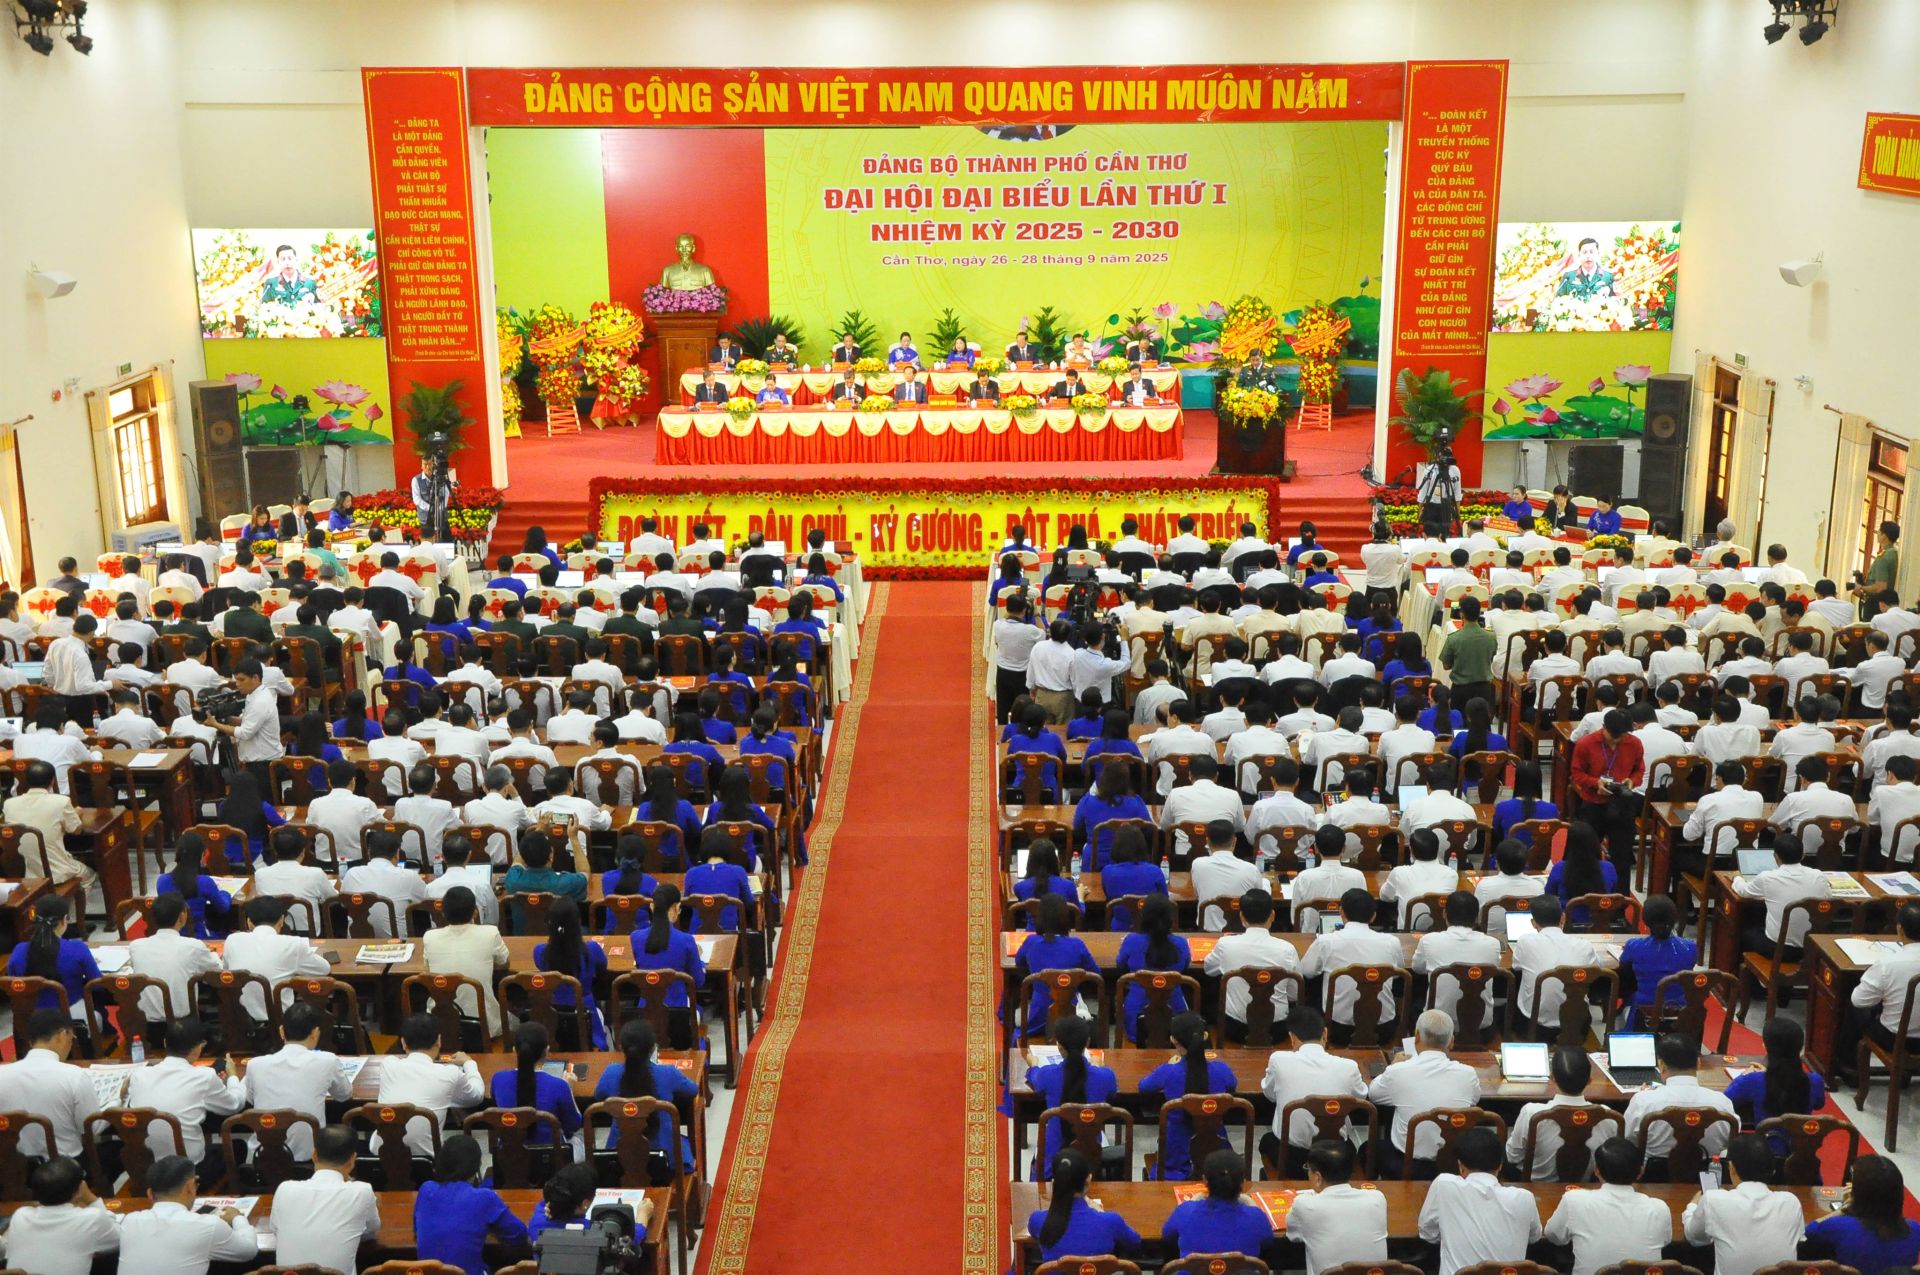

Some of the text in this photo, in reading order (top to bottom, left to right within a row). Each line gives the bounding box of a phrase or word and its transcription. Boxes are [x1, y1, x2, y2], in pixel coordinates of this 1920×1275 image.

[524, 71, 1348, 118] ĐẢNG CỘNG SẢN VIỆT NAM QUANG VINH MUÔN NĂM
[864, 150, 1188, 176] ĐẢNG BỘ THÀNH PHỐ CẦN THƠ
[824, 178, 1227, 213] ĐẠI HỘI ĐẠI BIỂU LẦN THỨ I
[872, 220, 962, 244] NHIỆM
[972, 220, 1006, 240] KỲ
[1016, 222, 1083, 240] 2025
[1112, 220, 1179, 239] 2030
[882, 255, 910, 266] Cần
[915, 255, 947, 266] Thơ,
[952, 255, 986, 267] ngày
[991, 256, 1008, 264] 26
[1022, 254, 1038, 264] 28
[1042, 253, 1083, 267] tháng
[1088, 254, 1096, 264] 9
[1100, 254, 1130, 264] năm
[1136, 253, 1168, 262] 2025
[871, 504, 898, 552] KỶ
[906, 508, 982, 552] CƯƠNG
